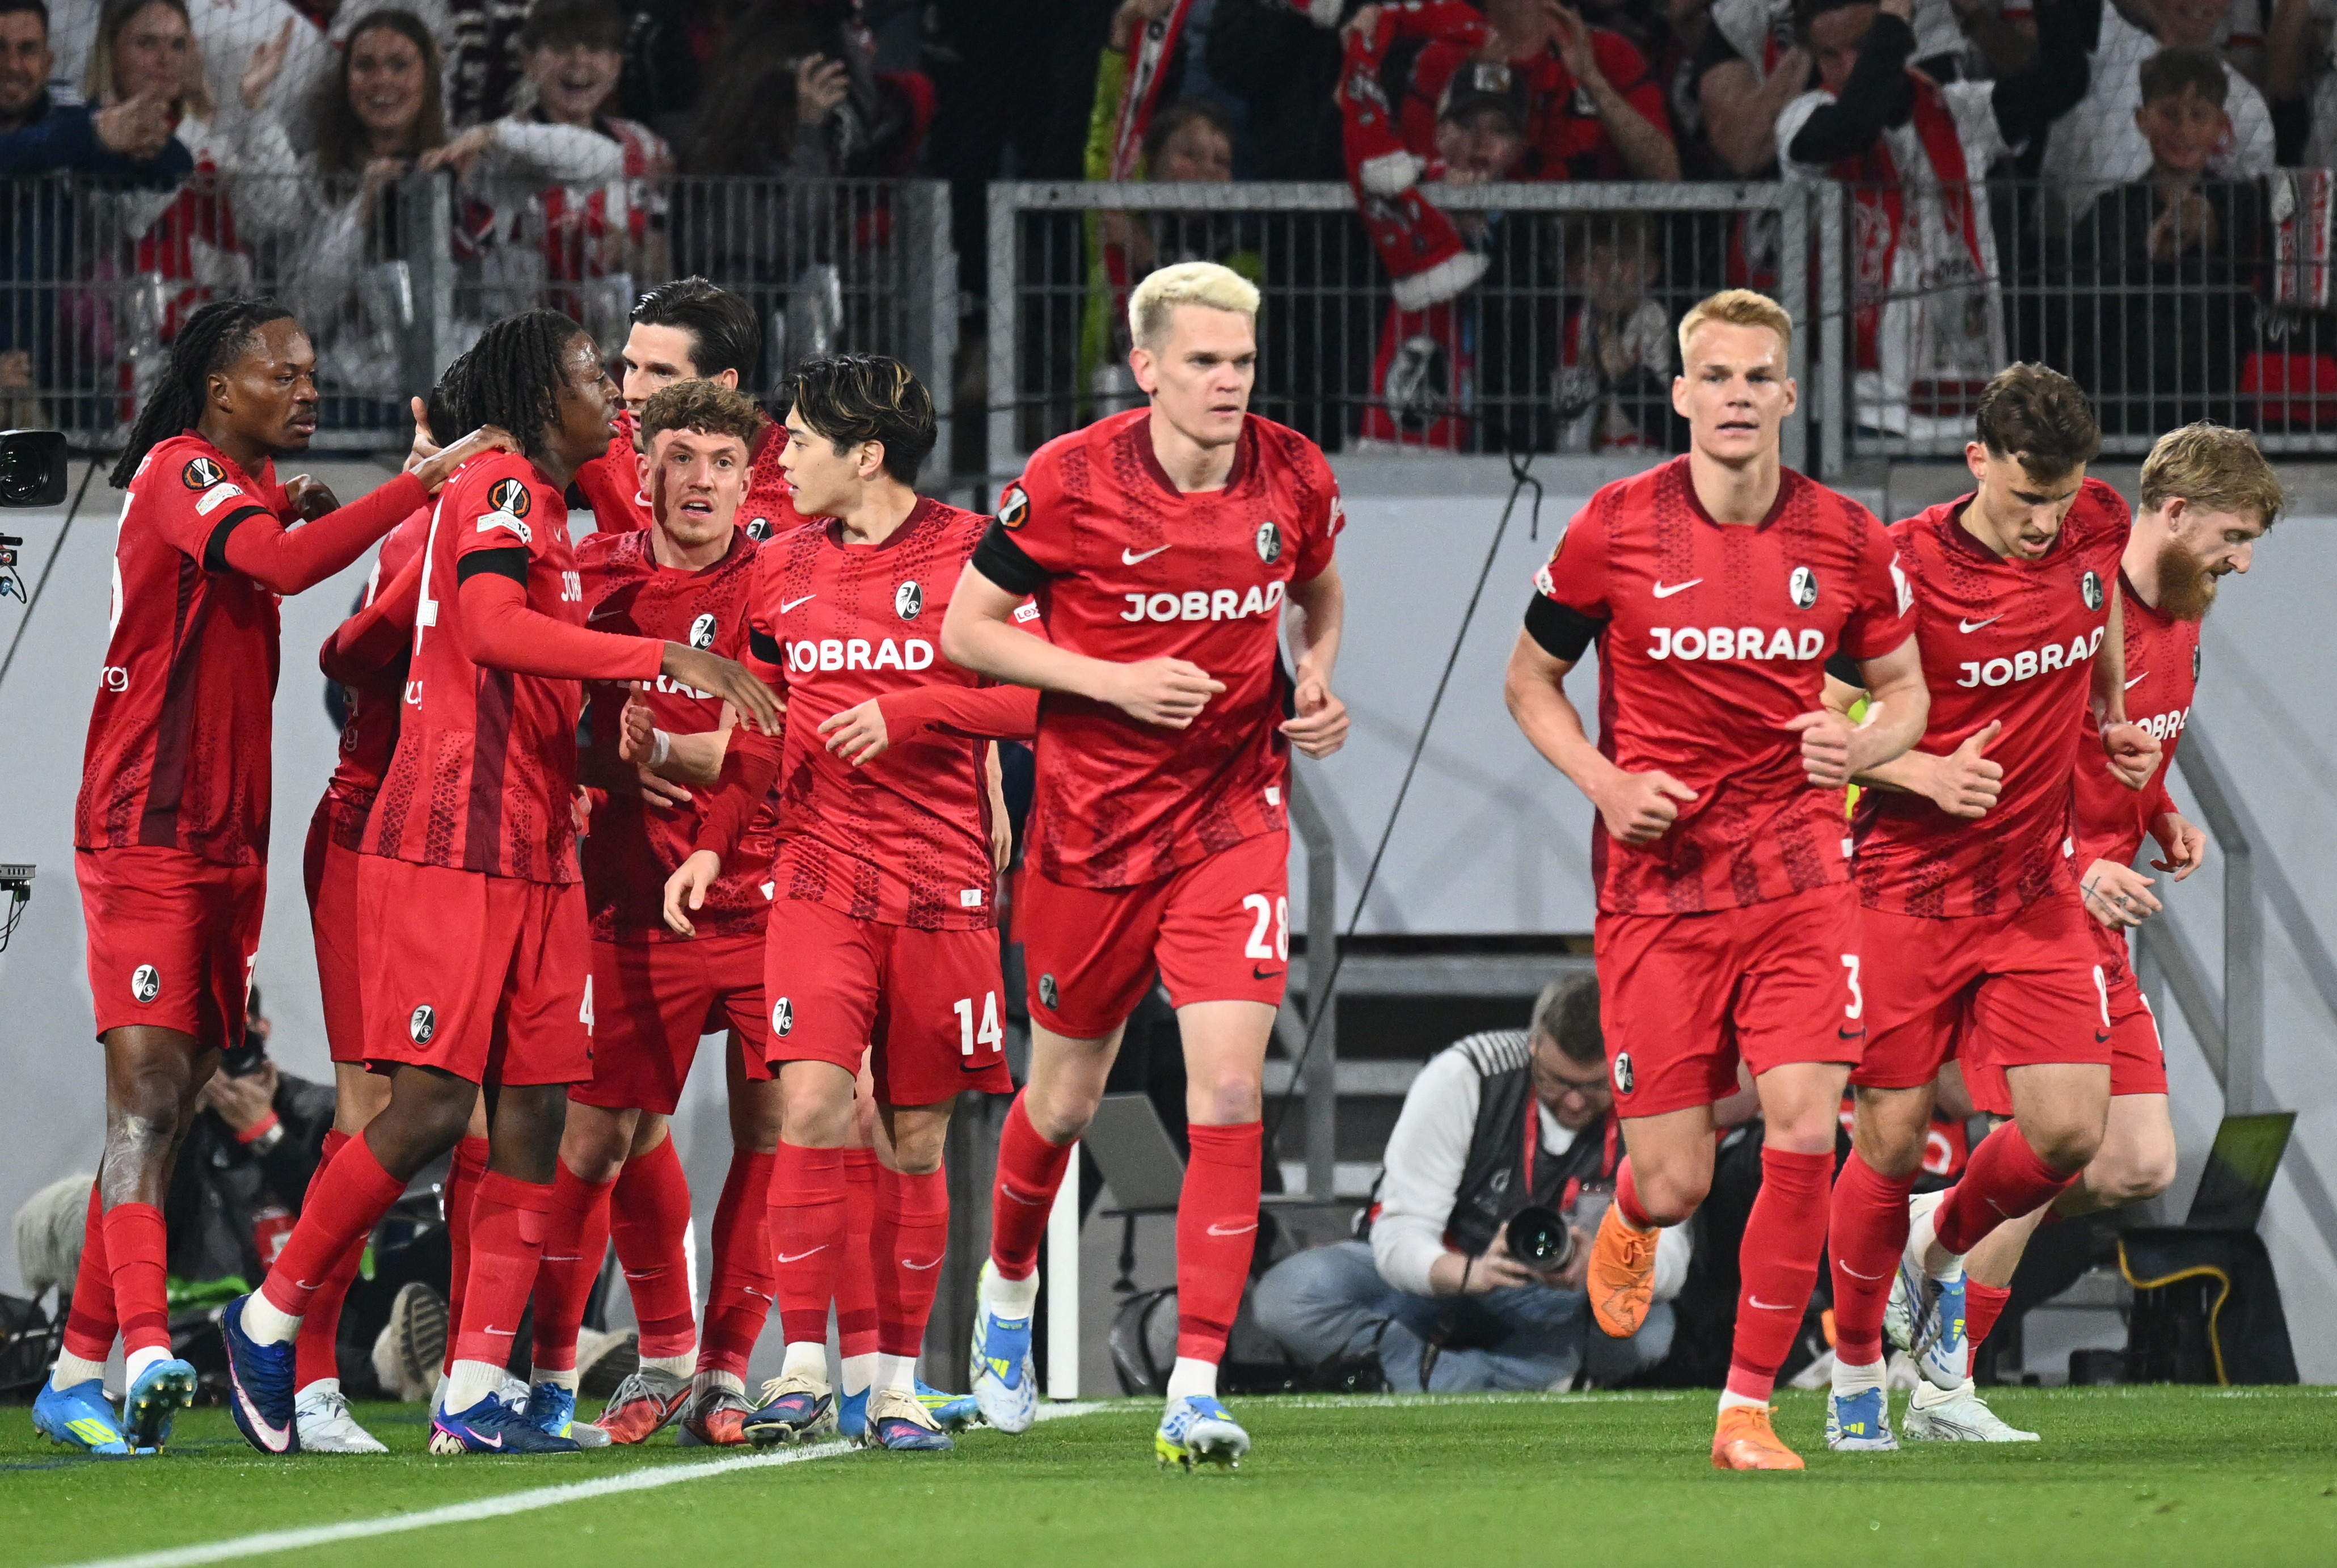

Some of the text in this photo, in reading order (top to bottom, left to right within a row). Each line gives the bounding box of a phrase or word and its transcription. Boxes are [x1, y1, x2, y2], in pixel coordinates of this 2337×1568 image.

[1120, 579, 1285, 622] JOBRAD
[785, 638, 934, 672] JOBRAD
[1647, 626, 1825, 660] JOBRAD
[1956, 626, 2105, 688] JOBRAD
[2126, 706, 2190, 741] OBR
[1242, 893, 1289, 963] 28
[579, 974, 594, 1036] 4
[1840, 954, 1863, 1019] 3
[954, 990, 1003, 1055] 14
